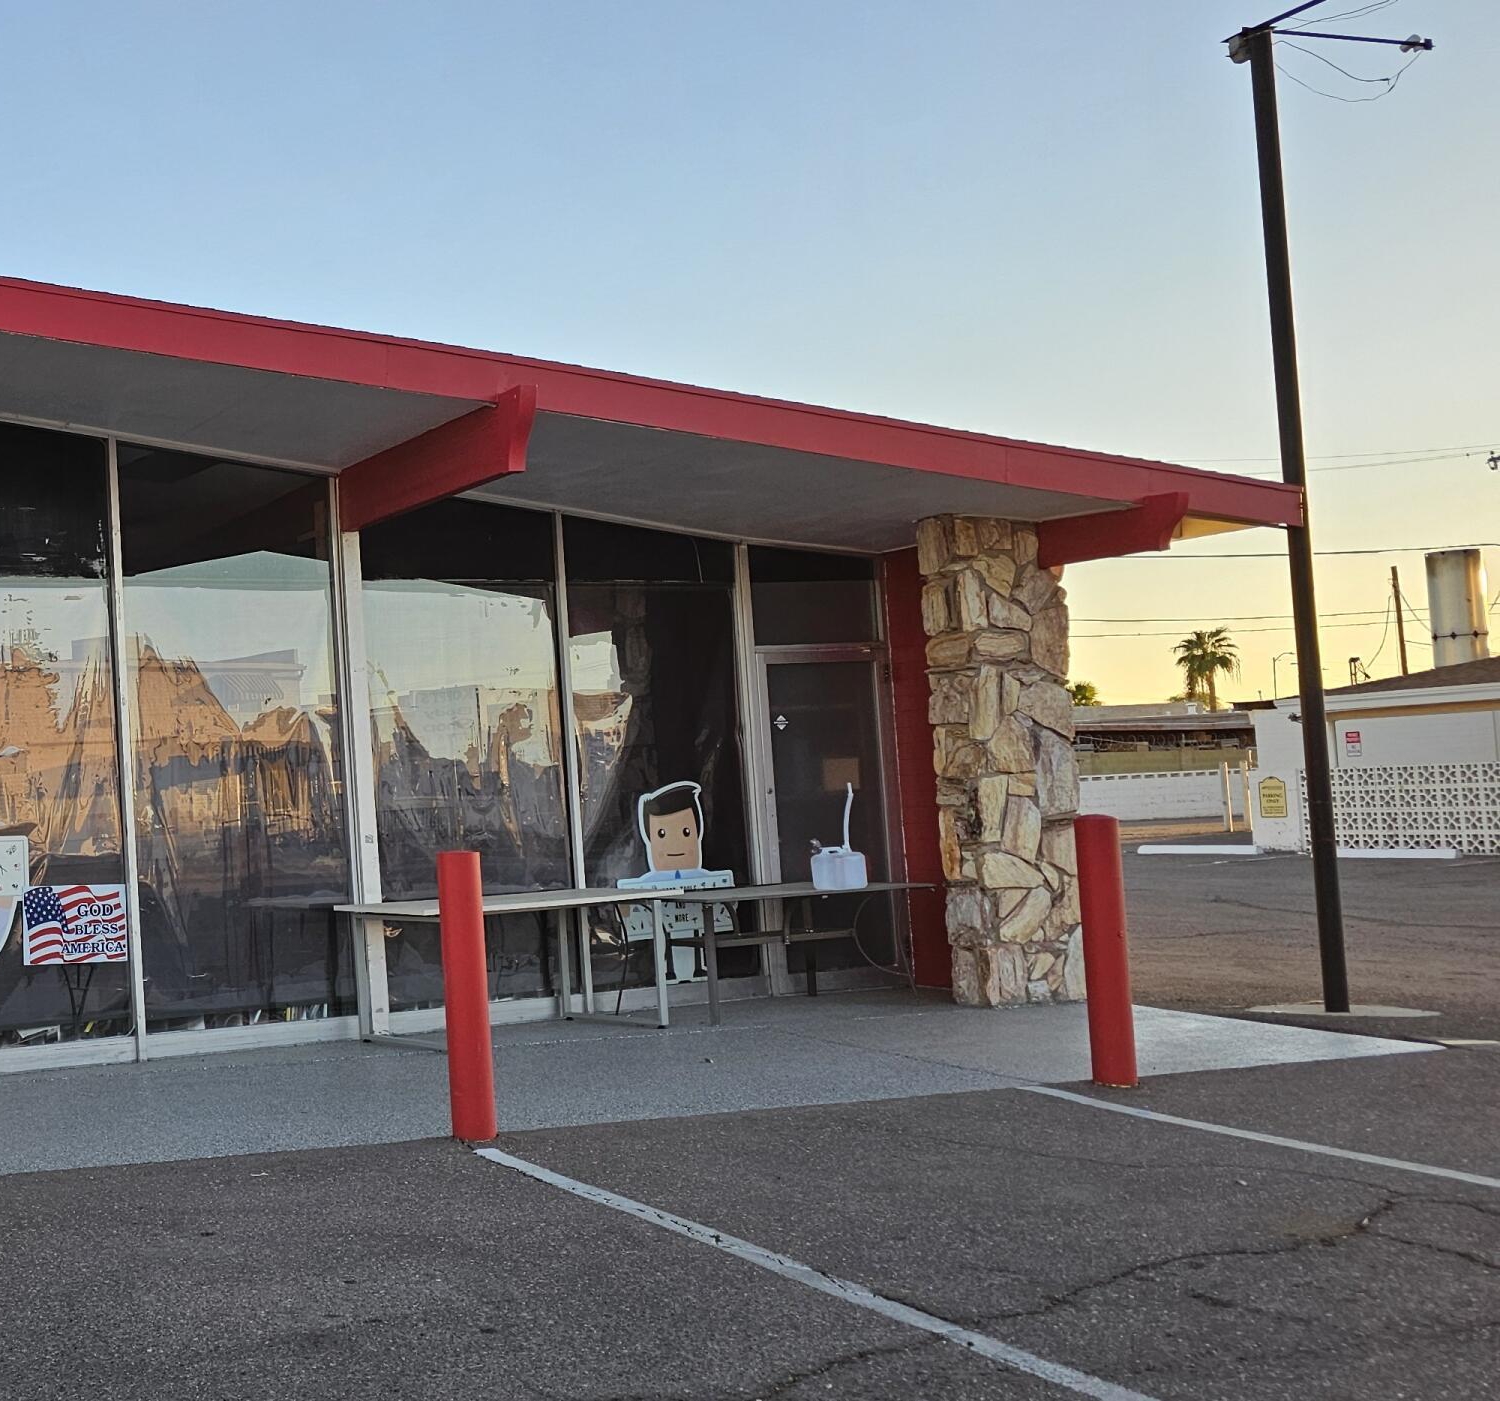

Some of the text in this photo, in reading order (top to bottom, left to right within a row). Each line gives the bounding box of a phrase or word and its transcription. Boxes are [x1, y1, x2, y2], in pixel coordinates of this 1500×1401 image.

[77, 903, 113, 917] GOD
[74, 923, 118, 935] BLESS
[61, 941, 124, 954] AMERICA
